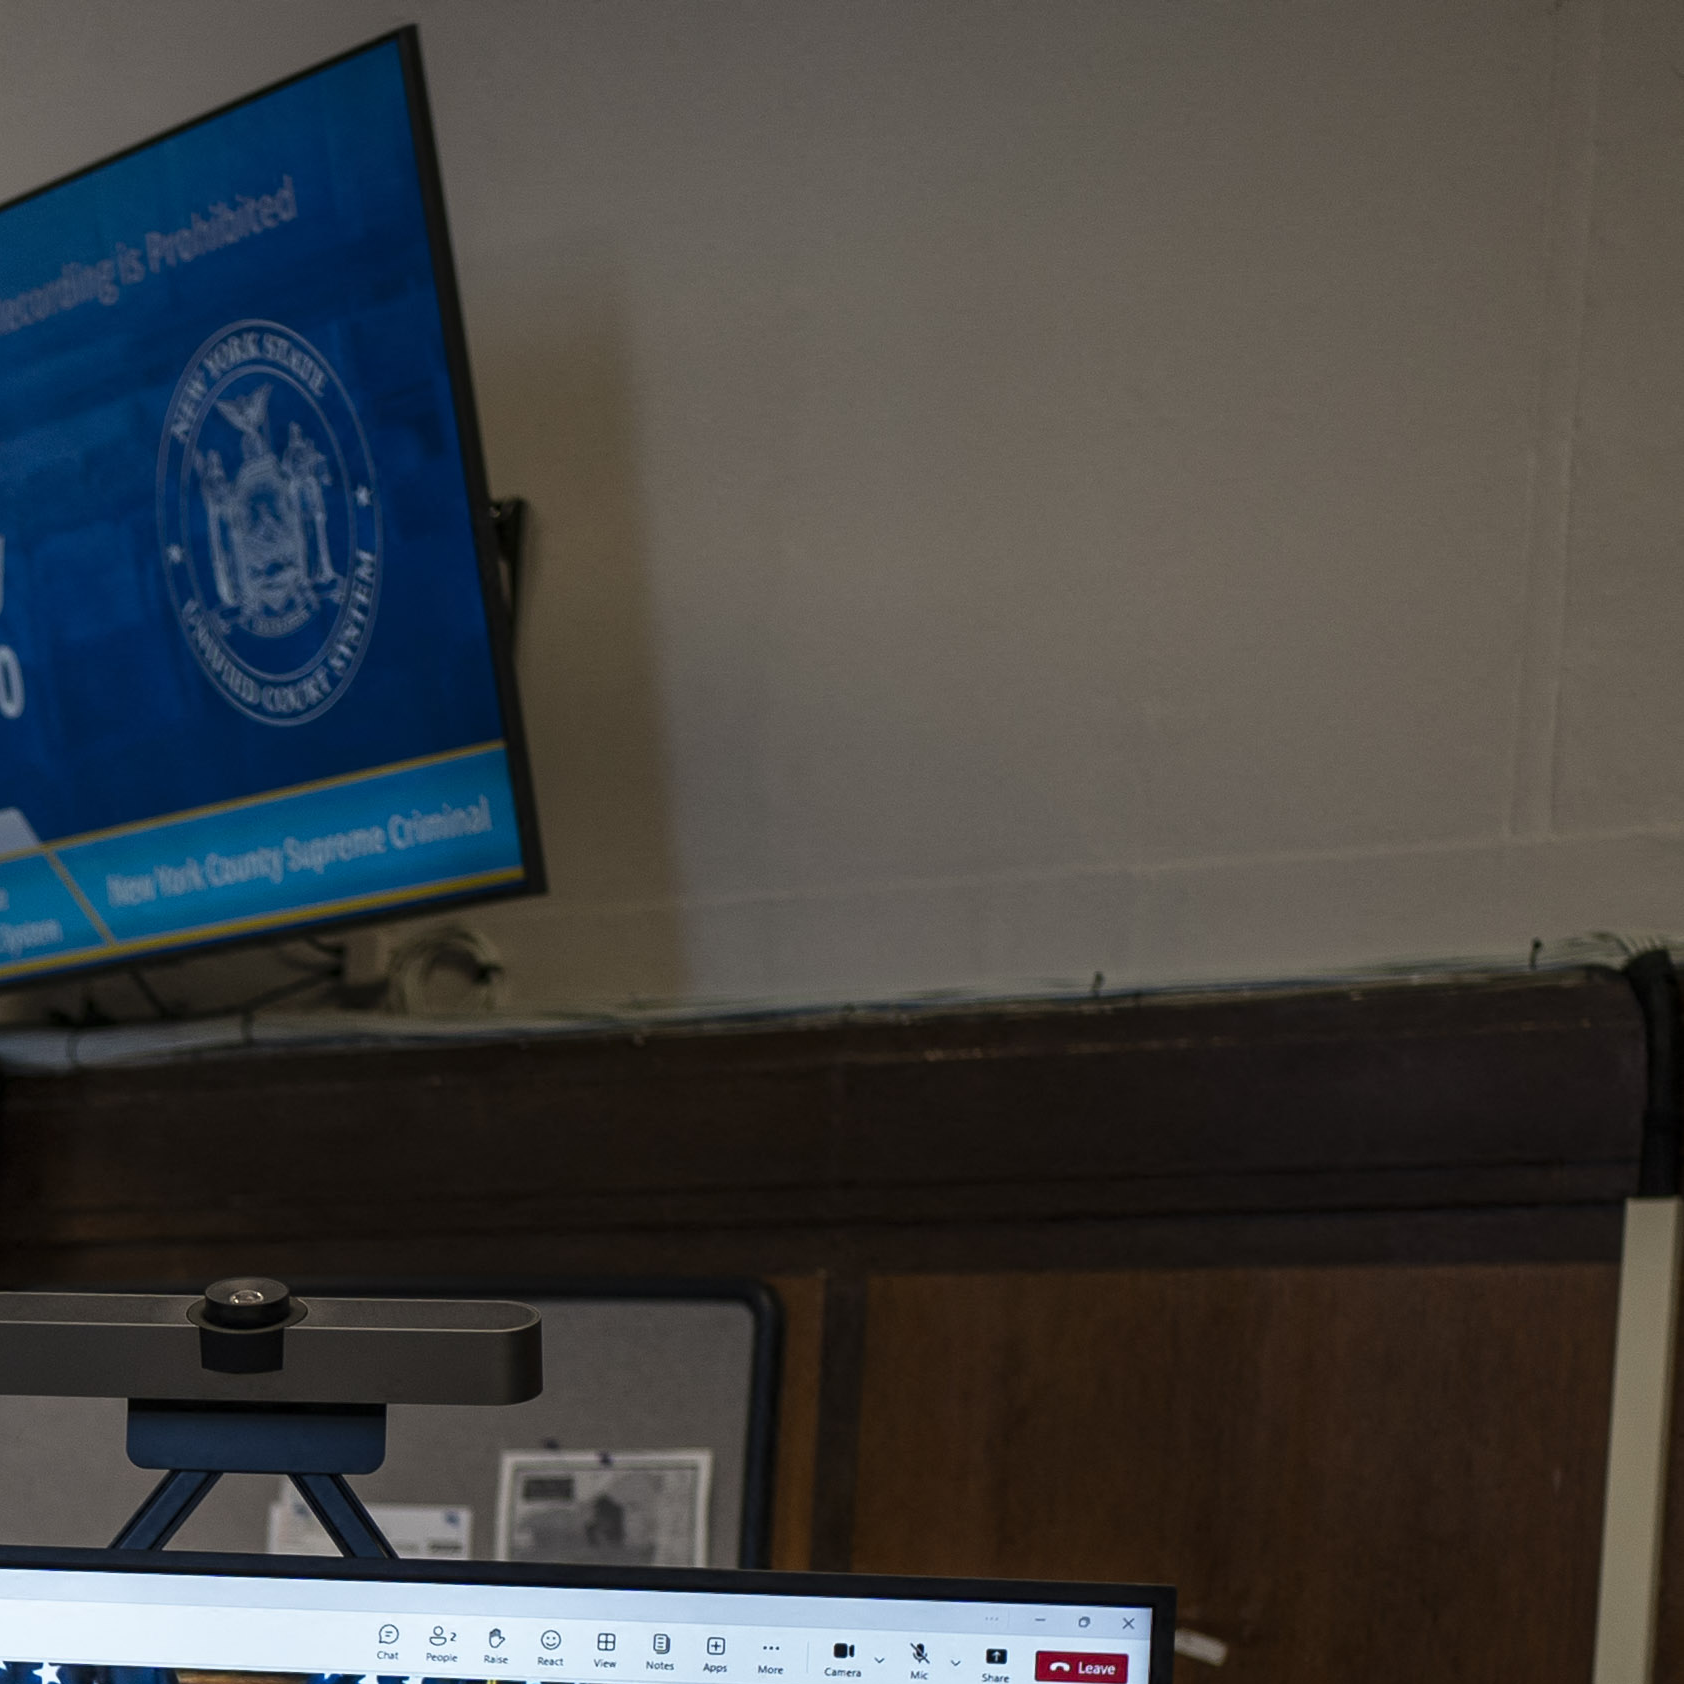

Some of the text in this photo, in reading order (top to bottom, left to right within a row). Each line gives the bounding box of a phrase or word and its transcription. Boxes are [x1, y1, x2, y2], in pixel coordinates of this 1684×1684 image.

[116, 241, 145, 284] is
[145, 174, 297, 273] Prohibited
[171, 332, 330, 444] NEW YORK STATE
[262, 665, 332, 713] COURT
[328, 548, 376, 677] SYSTEM
[106, 793, 493, 907] New York County Supreme Criminal
[450, 1632, 458, 1642] 2
[377, 1650, 399, 1660] Chat
[426, 1652, 458, 1663] People
[484, 1655, 508, 1665] Raise
[537, 1656, 564, 1667] React
[593, 1658, 617, 1669] View
[645, 1661, 674, 1672] Notes
[703, 1663, 728, 1675] Apps
[758, 1665, 784, 1676] More
[824, 1666, 862, 1678] Camera
[910, 1669, 928, 1680] Mic
[1078, 1662, 1117, 1676] Leave
[981, 1672, 1010, 1684] Share
